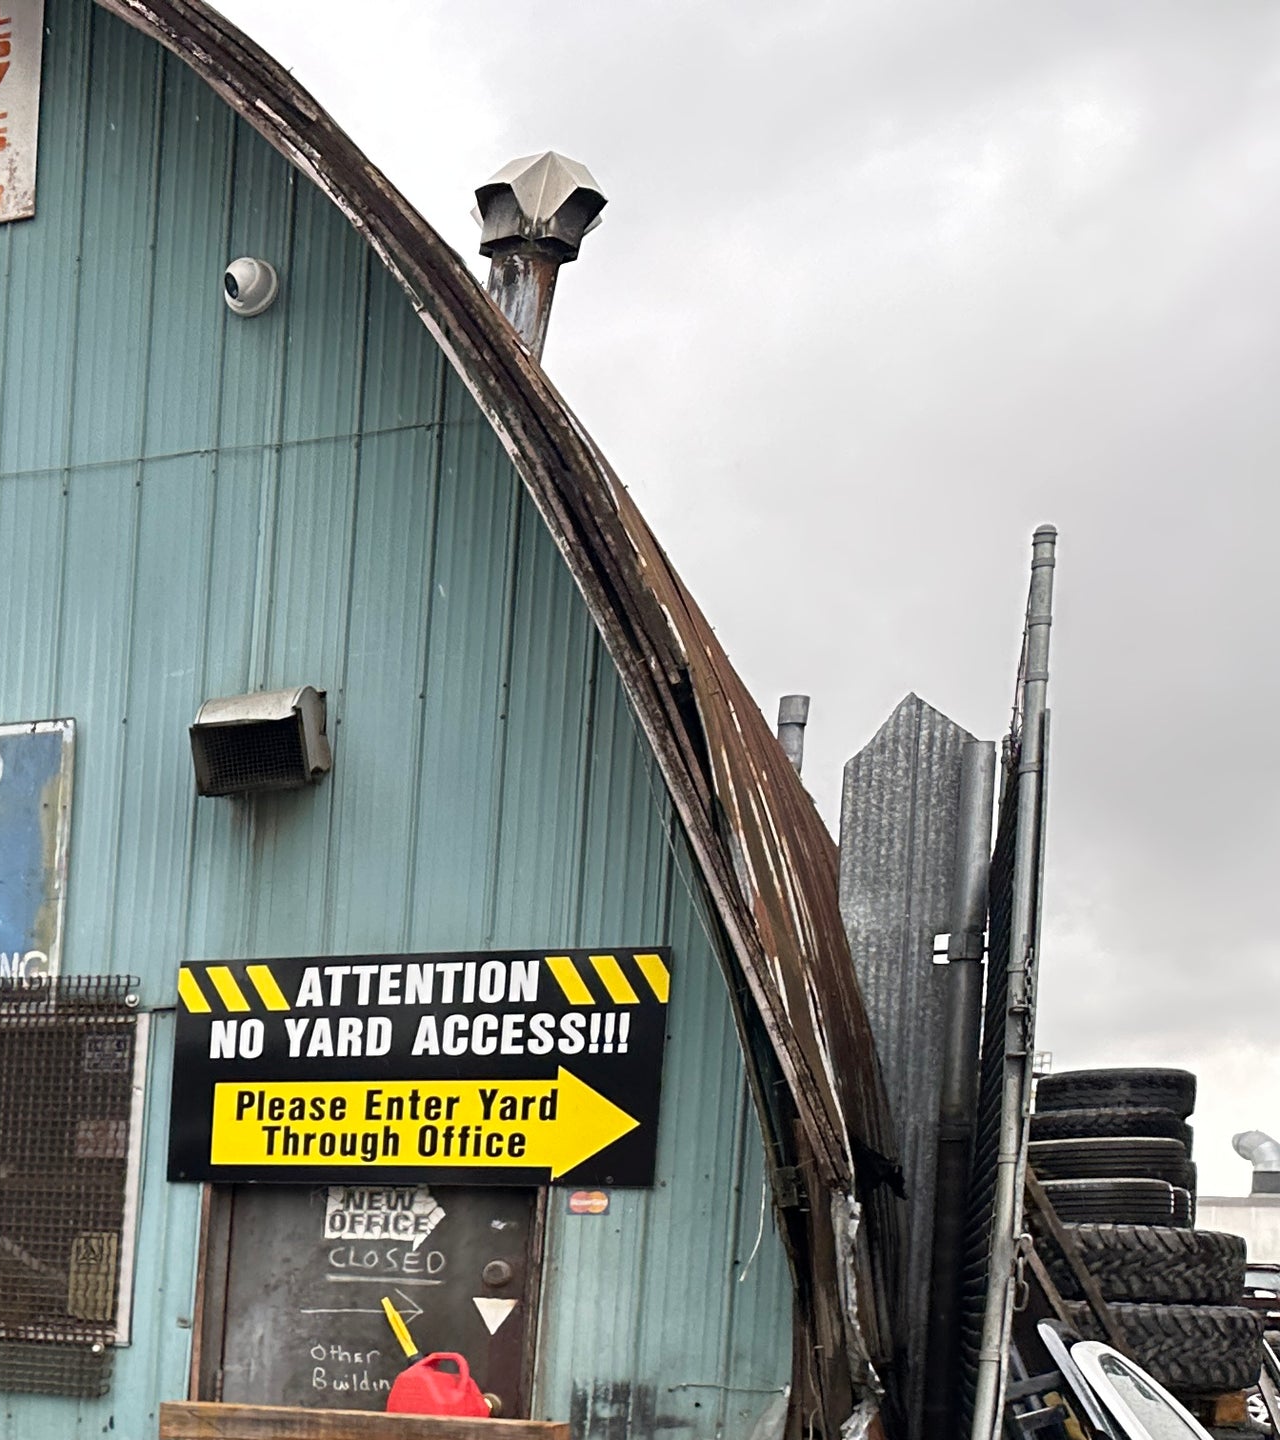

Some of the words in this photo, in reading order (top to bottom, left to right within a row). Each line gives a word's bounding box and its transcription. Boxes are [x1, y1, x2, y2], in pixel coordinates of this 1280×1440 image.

[295, 960, 540, 1007] ATTENTION
[209, 1020, 264, 1059] NO
[284, 1016, 393, 1057] YARD
[411, 1012, 631, 1055] ACCESS!!!
[235, 1089, 347, 1121] Please
[364, 1089, 460, 1121] Enter
[480, 1088, 558, 1121] Yard
[261, 1125, 401, 1162] Through
[418, 1124, 527, 1158] Office
[344, 1188, 412, 1211] NEW
[329, 1209, 430, 1234] OFFICE
[328, 1246, 445, 1274] CLOSED
[312, 1366, 391, 1391] Buildin
